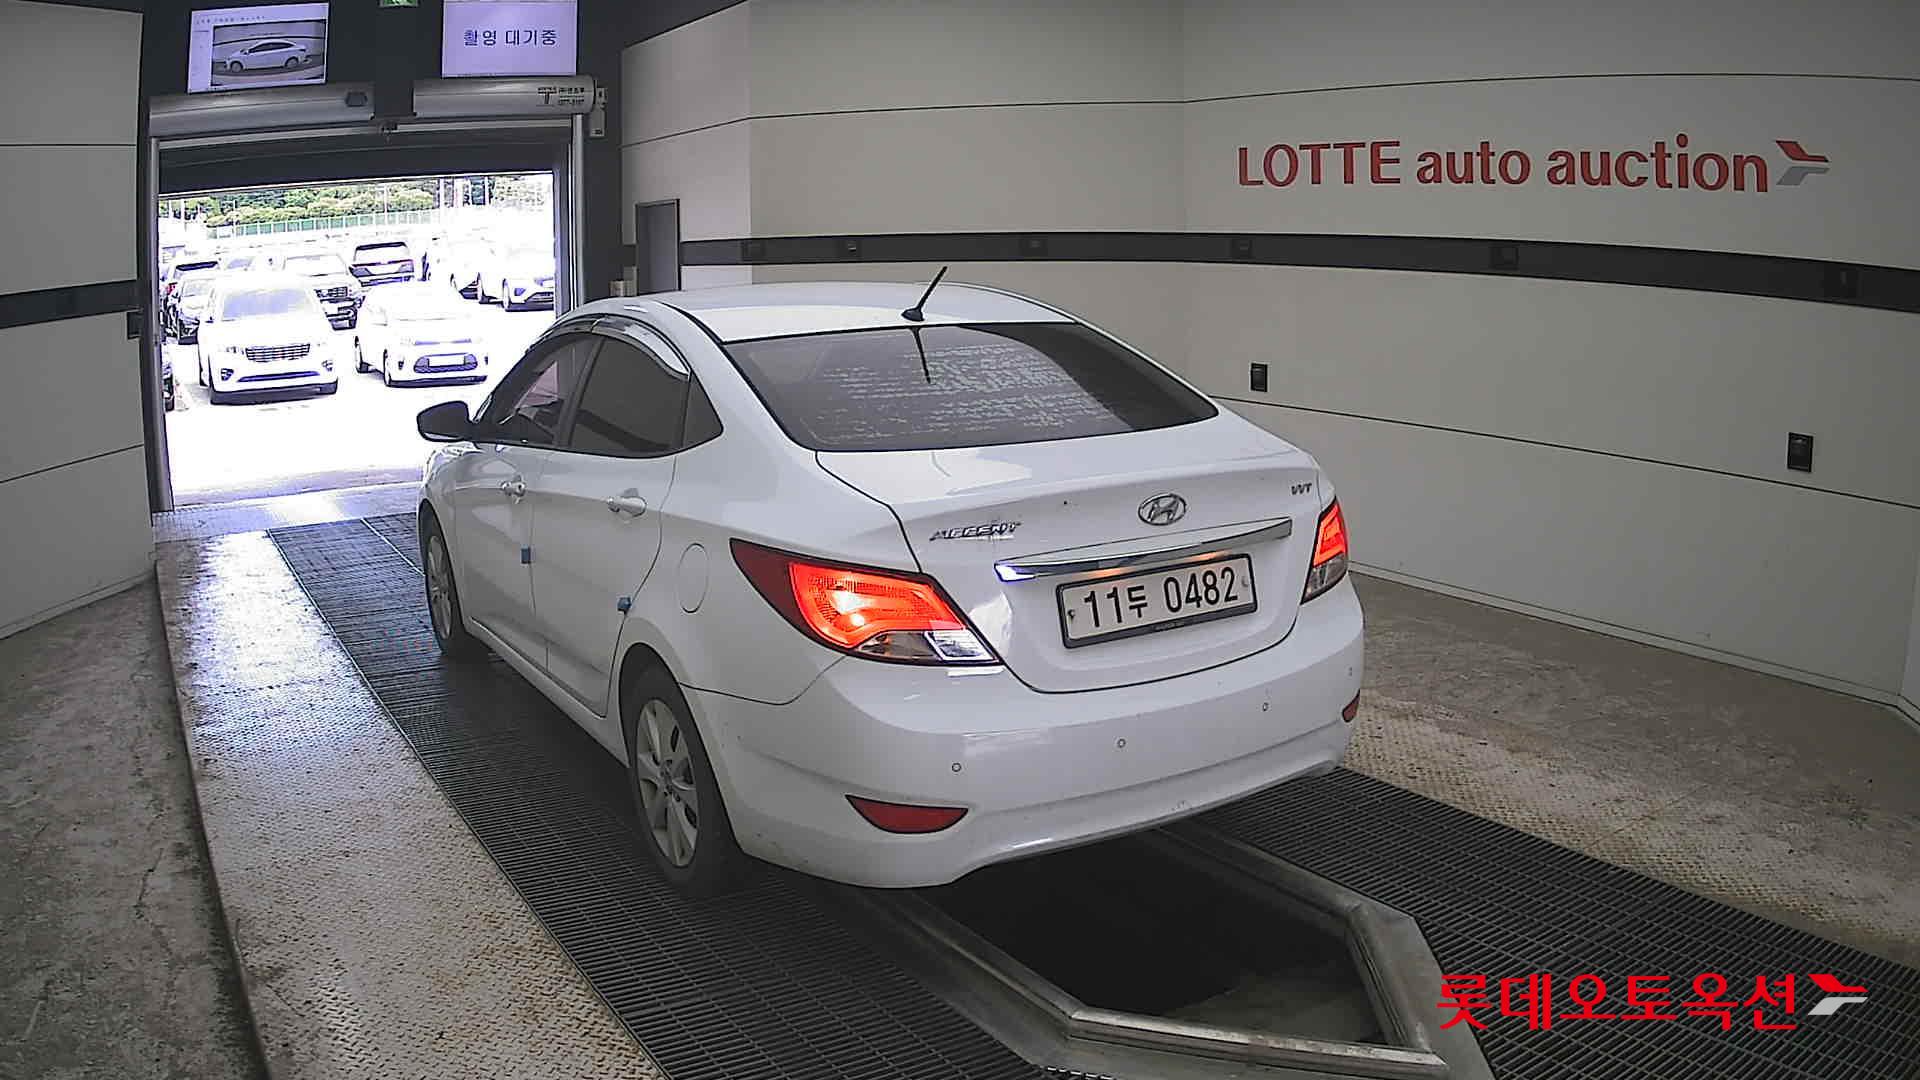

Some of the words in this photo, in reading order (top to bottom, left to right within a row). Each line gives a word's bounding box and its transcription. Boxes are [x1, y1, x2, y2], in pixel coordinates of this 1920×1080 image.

[504, 28, 558, 47] 대기중
[1238, 140, 1402, 187] LOTTE
[1415, 140, 1531, 185] auto
[1546, 132, 1769, 193] auction
[928, 520, 1022, 542] ACCENT
[1084, 585, 1148, 628] 11두
[1163, 566, 1239, 613] 0482
